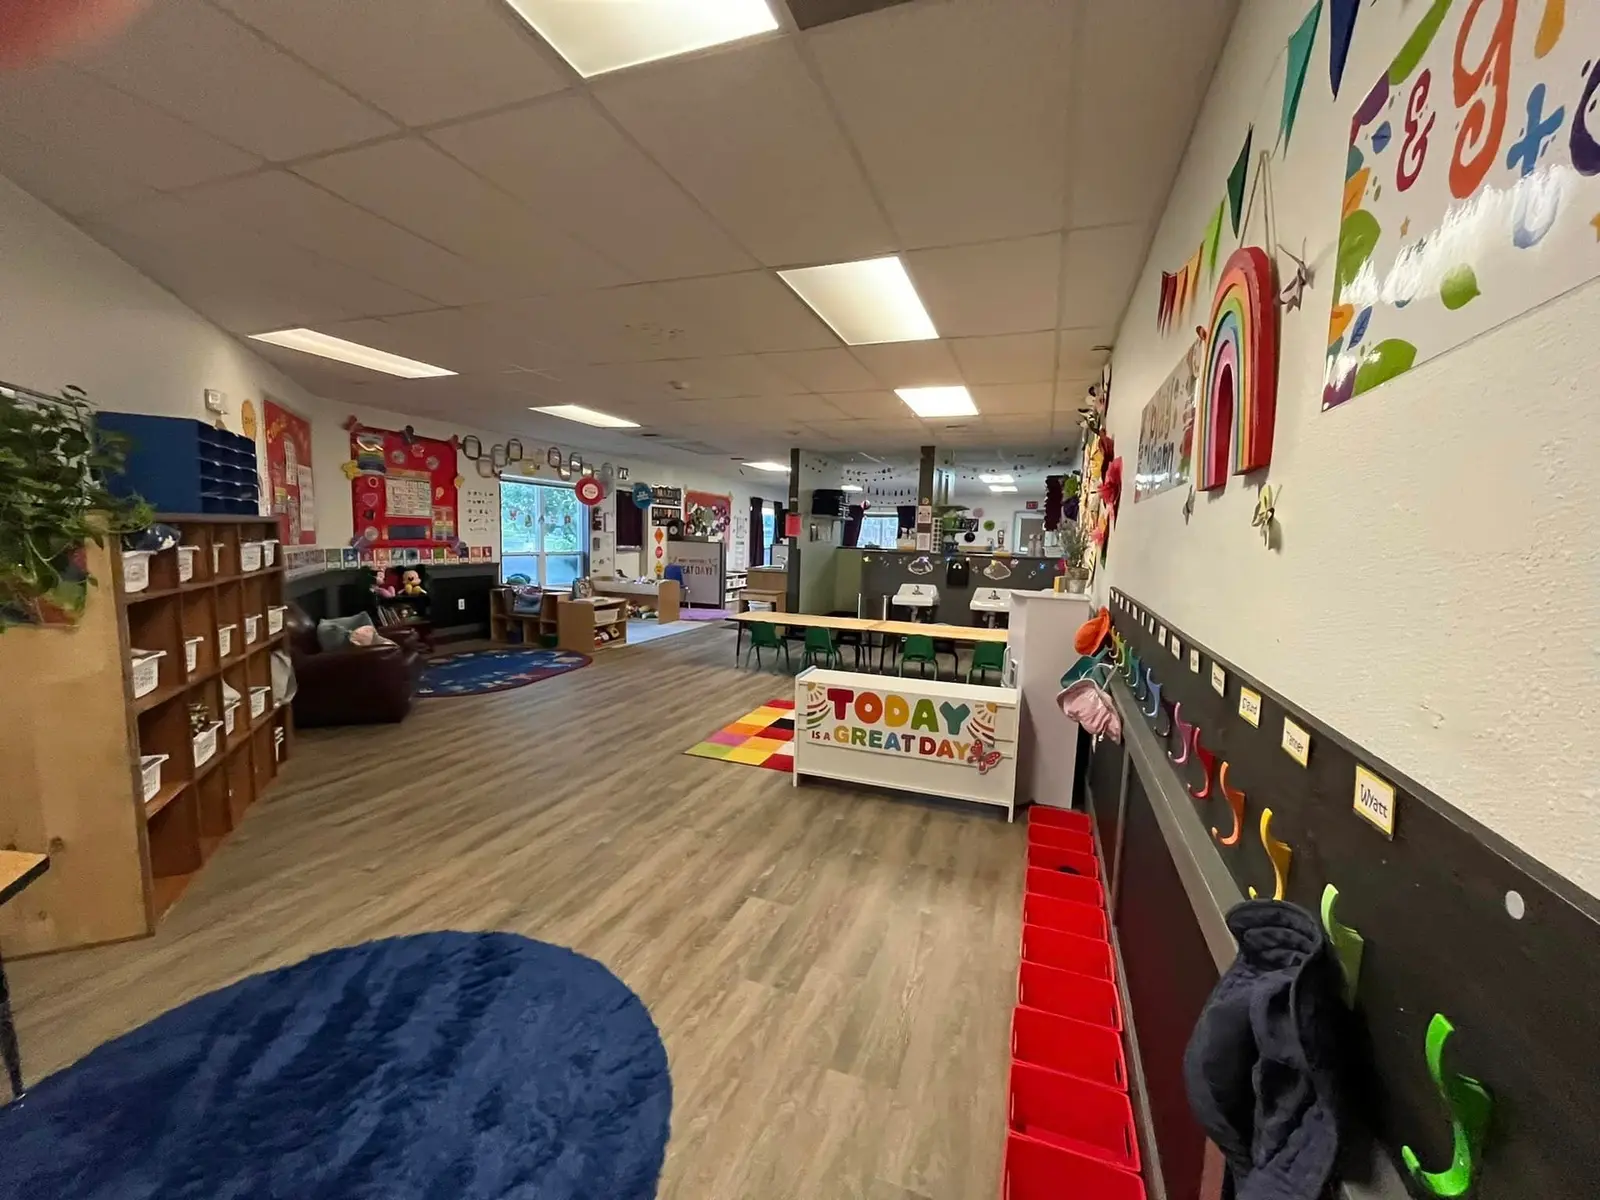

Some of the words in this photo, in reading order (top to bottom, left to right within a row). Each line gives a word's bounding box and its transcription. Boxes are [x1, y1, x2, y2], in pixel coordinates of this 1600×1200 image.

[827, 688, 971, 735] TODAY
[811, 730, 821, 740] IS
[823, 732, 831, 741] A
[833, 725, 916, 753] GREAT
[919, 736, 970, 760] DAY
[1360, 783, 1388, 819] Wyatt
